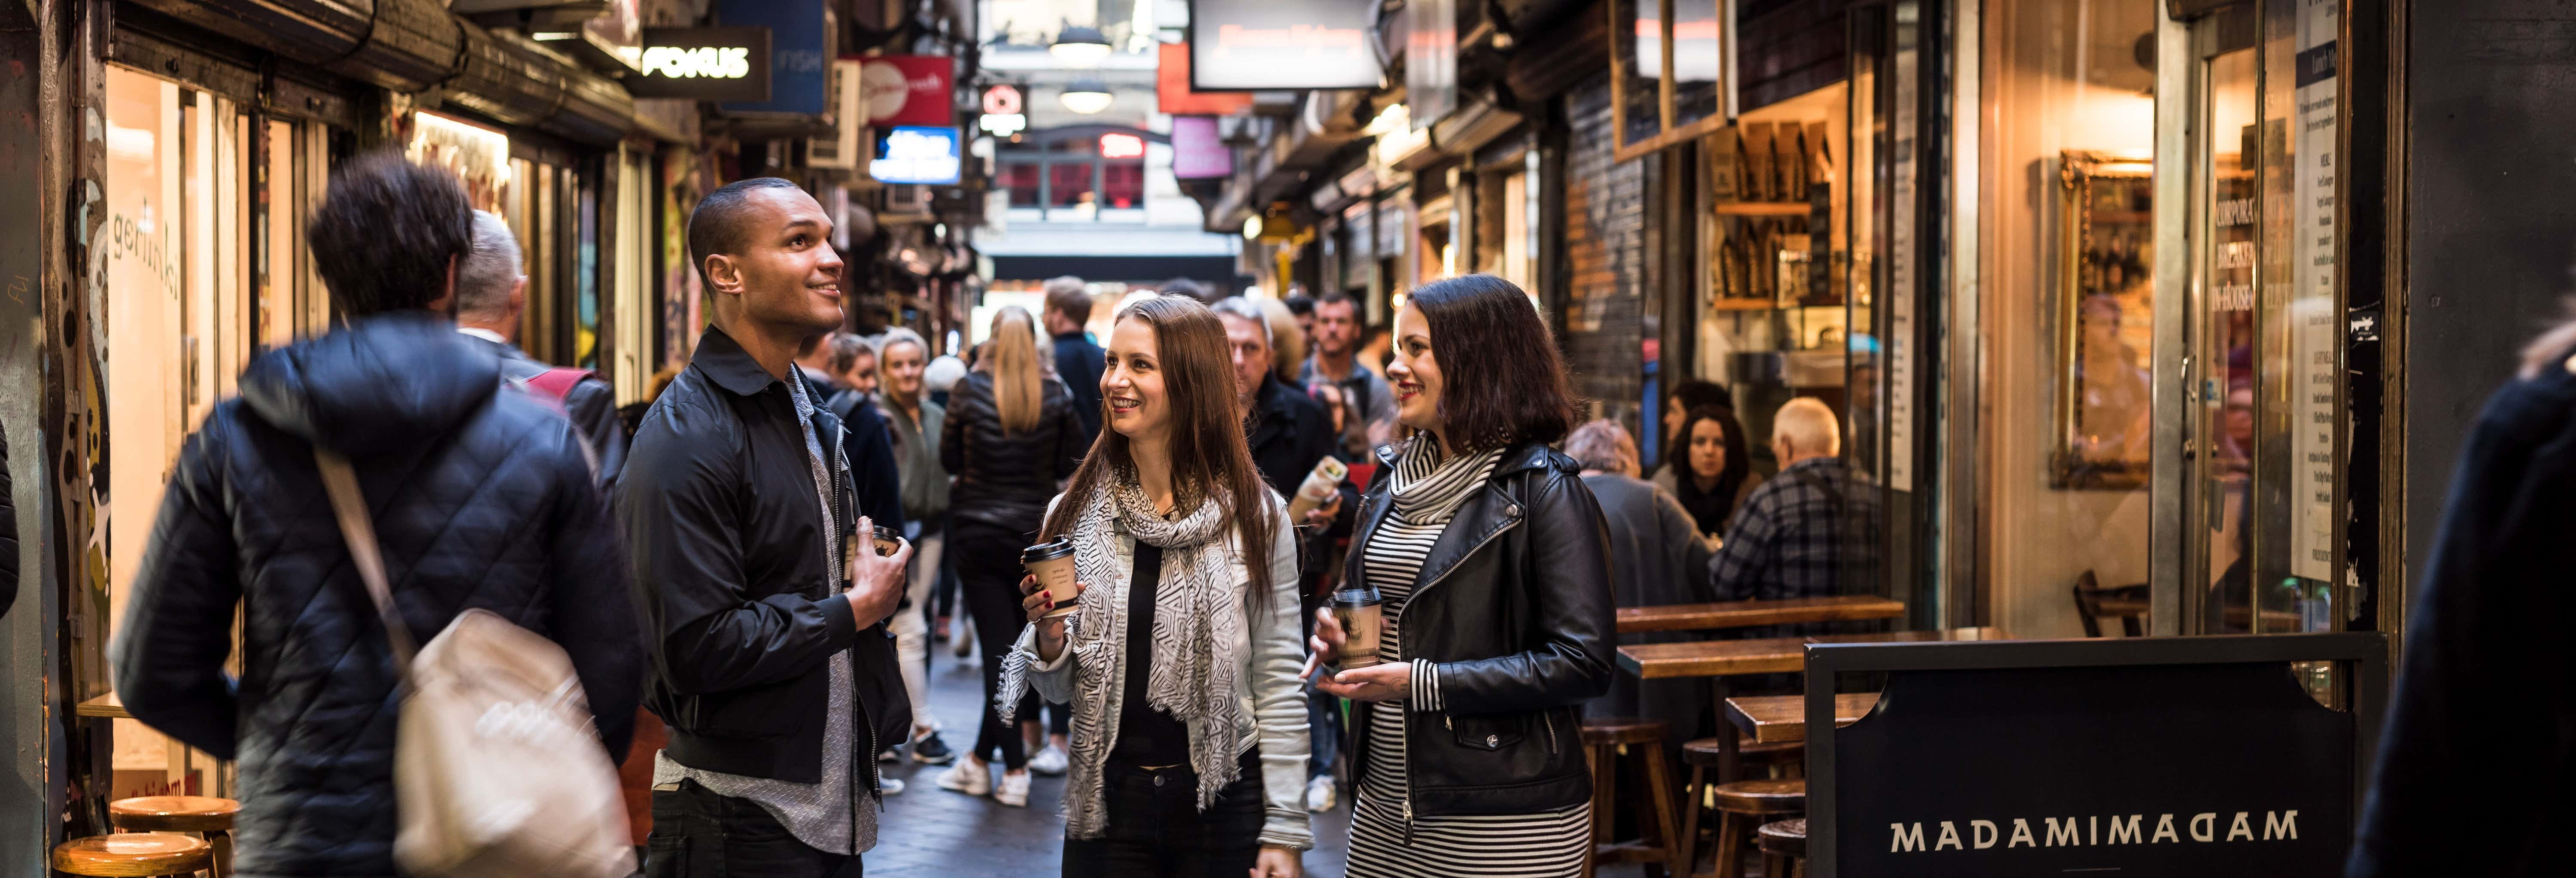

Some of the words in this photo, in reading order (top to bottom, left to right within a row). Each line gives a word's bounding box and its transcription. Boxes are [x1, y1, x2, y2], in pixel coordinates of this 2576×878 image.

[642, 46, 750, 79] FOKUS
[2217, 197, 2254, 227] CORPORA
[114, 196, 177, 300] gerlinki
[2218, 241, 2254, 269] BREAKFA
[2324, 350, 2333, 364] MEAL
[1891, 810, 2298, 852] MADAMIMADAM
